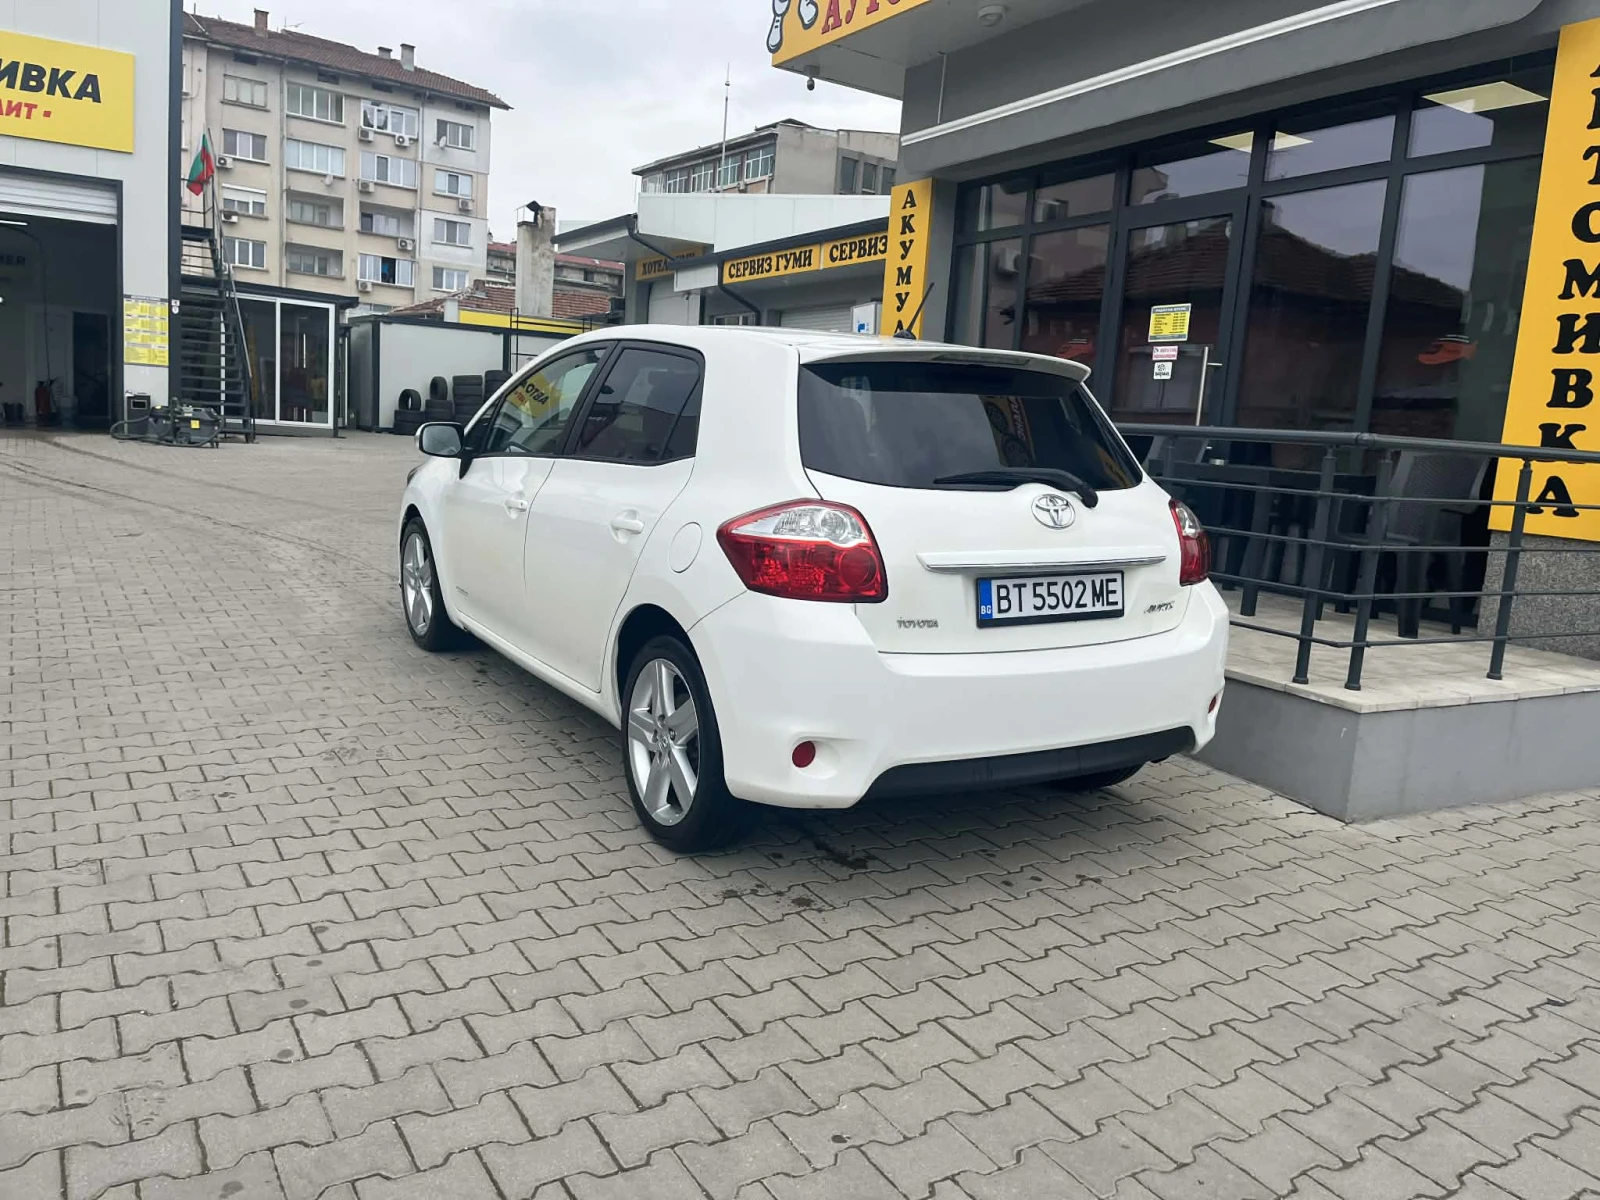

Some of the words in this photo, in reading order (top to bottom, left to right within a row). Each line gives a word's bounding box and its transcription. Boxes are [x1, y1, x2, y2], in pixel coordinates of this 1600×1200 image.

[0, 99, 38, 119] ИТ
[828, 234, 888, 263] СЕРВИЗ
[728, 257, 773, 279] СЕРВИЗ
[775, 248, 813, 272] ГУМИ
[980, 605, 992, 615] BG
[996, 583, 1027, 614] BT
[1032, 580, 1088, 611] 5502
[1091, 577, 1119, 607] ME
[896, 619, 939, 629] TOYOTA
